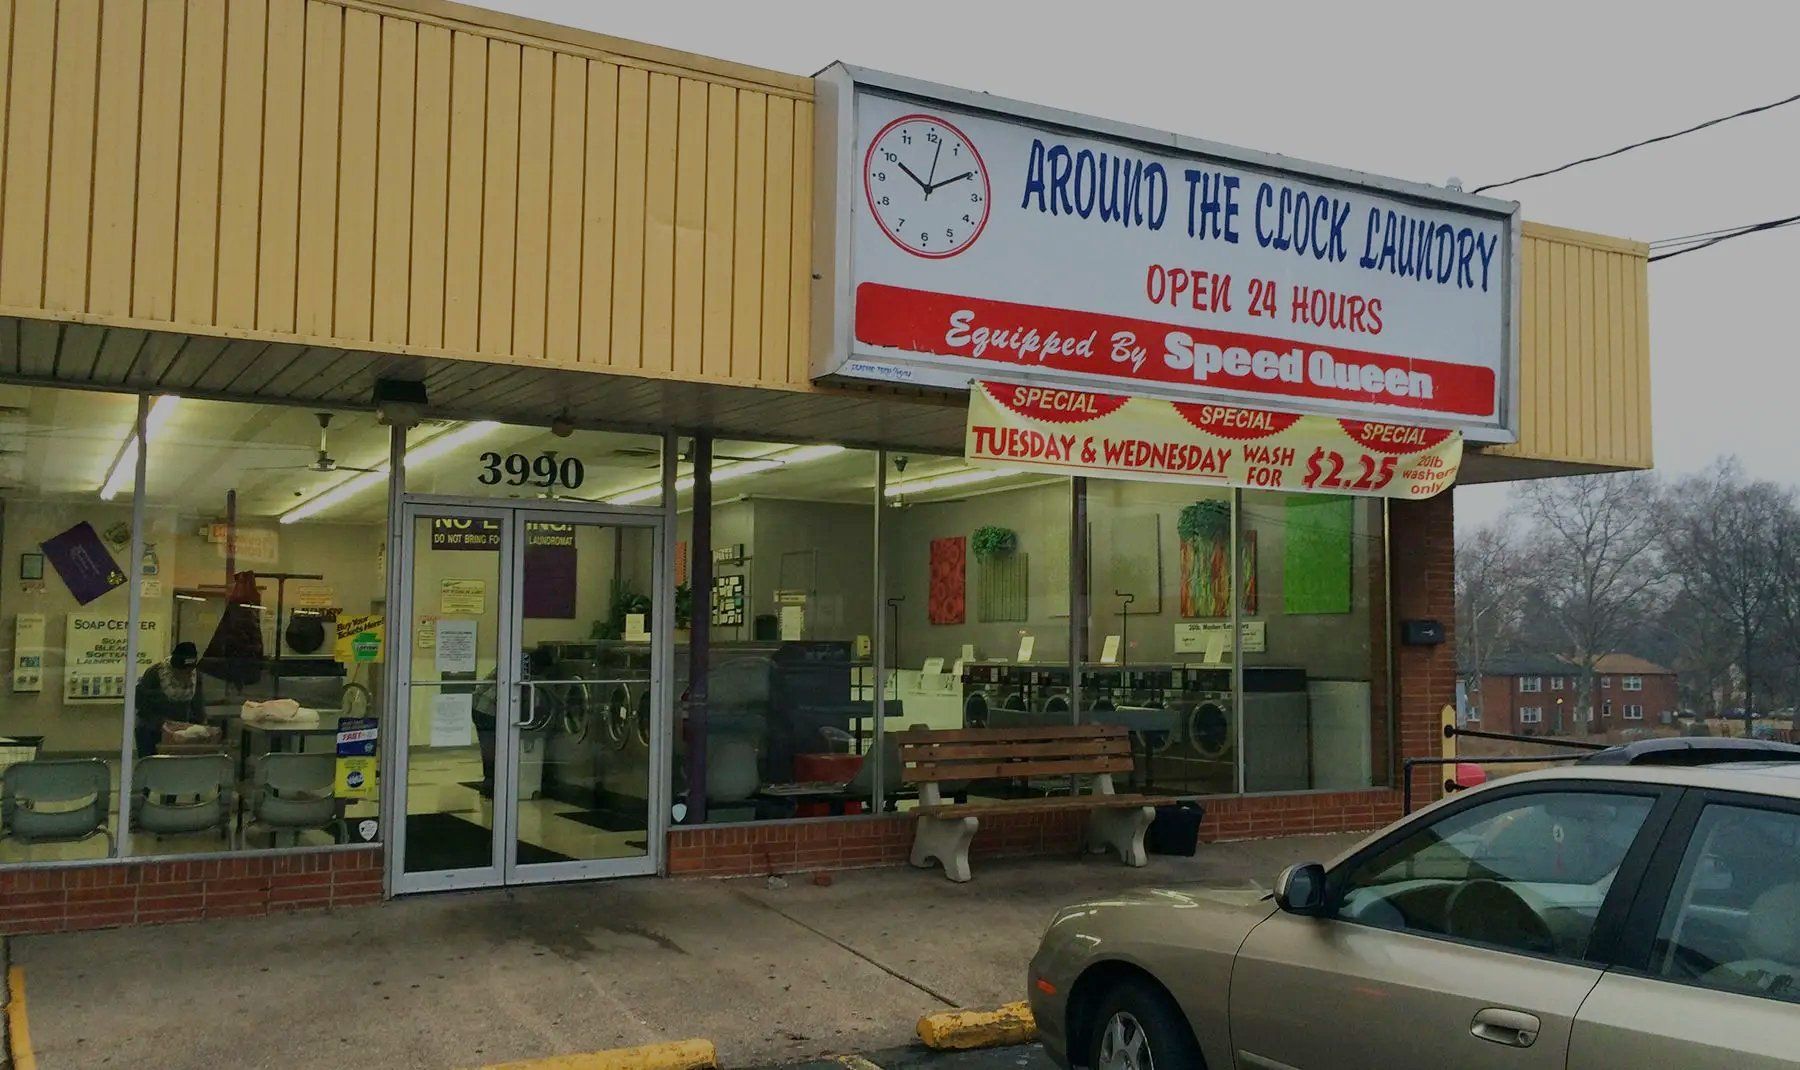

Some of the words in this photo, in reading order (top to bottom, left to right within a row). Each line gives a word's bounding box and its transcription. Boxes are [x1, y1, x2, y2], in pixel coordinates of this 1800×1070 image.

[902, 135, 912, 145] 11
[926, 133, 938, 144] 12
[884, 152, 897, 163] 10
[953, 147, 958, 156] 1
[878, 172, 886, 181] 9
[965, 172, 973, 181] 2
[882, 196, 890, 206] 8
[971, 193, 978, 203] 3
[962, 214, 970, 223] 4
[1021, 138, 1168, 231] AROUND
[1184, 168, 1240, 244] THE
[1255, 182, 1351, 262] CLOCK
[1360, 207, 1497, 292] LAUNDRY
[898, 218, 905, 227] 7
[921, 232, 928, 242] 6
[946, 228, 954, 238] 5
[1147, 264, 1232, 313] OPEN
[1247, 278, 1277, 320] 24
[1291, 285, 1383, 335] HOURS
[945, 309, 1098, 361] Equipped
[1110, 331, 1147, 373] By
[1163, 331, 1304, 382] Speed
[1308, 350, 1434, 399] Queen
[1012, 386, 1099, 414] SPECIAL
[1200, 405, 1276, 431] SPECIAL
[1361, 422, 1426, 446] SPECIAL
[972, 425, 1077, 462] TUESDAY
[1080, 436, 1097, 465] &
[1103, 438, 1231, 474] WEDNESDAY
[1243, 443, 1296, 467] WASH
[1417, 455, 1444, 468] 20lb
[478, 452, 585, 490] 3990
[1303, 446, 1399, 491] $2.25
[1246, 466, 1283, 487] FOR
[1411, 481, 1444, 495] only
[434, 533, 445, 544] DO
[447, 534, 462, 544] NOT
[464, 534, 487, 545] BRING
[74, 618, 106, 630] SOAP
